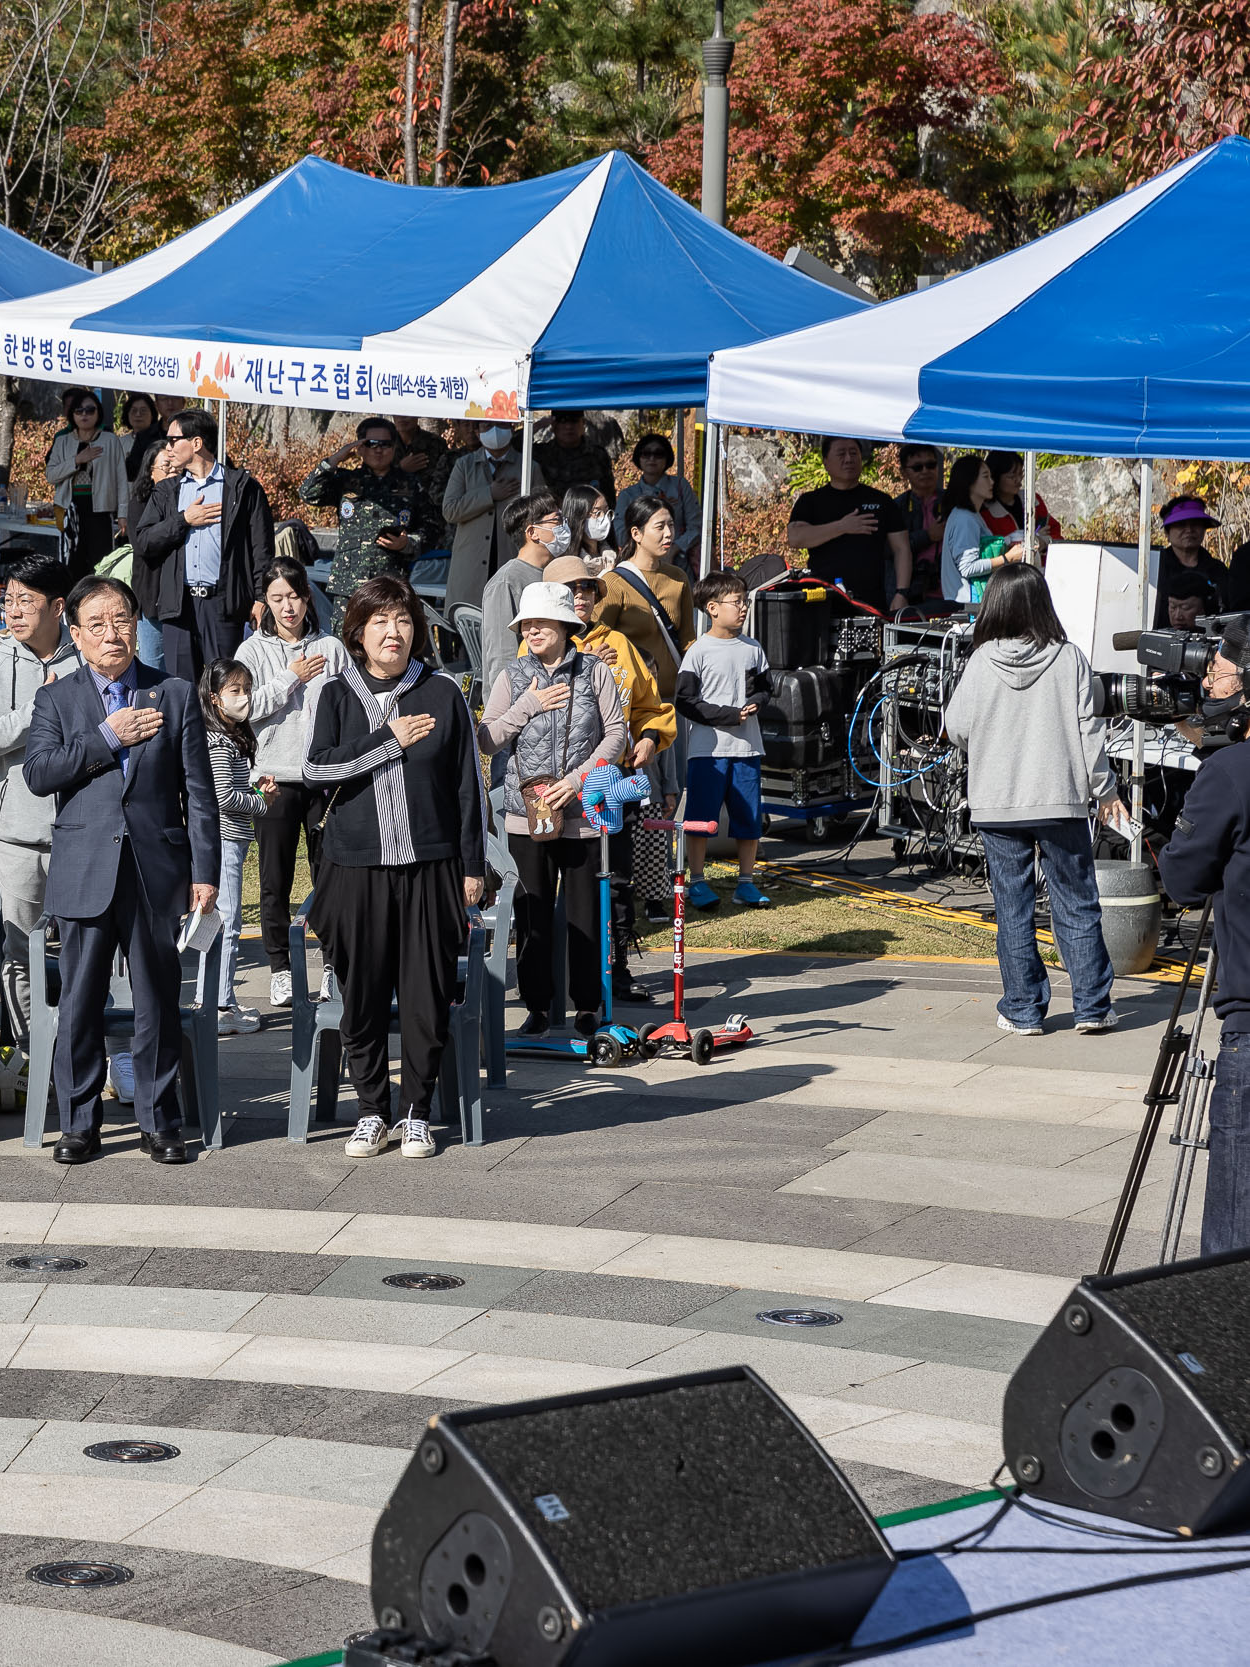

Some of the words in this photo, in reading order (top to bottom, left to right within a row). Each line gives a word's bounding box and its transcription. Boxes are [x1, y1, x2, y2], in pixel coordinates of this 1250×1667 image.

[137, 355, 180, 379] 건강상담)
[245, 358, 373, 401] 재난구조협회
[376, 372, 438, 399] (심폐소생술
[440, 376, 469, 401] 체험)
